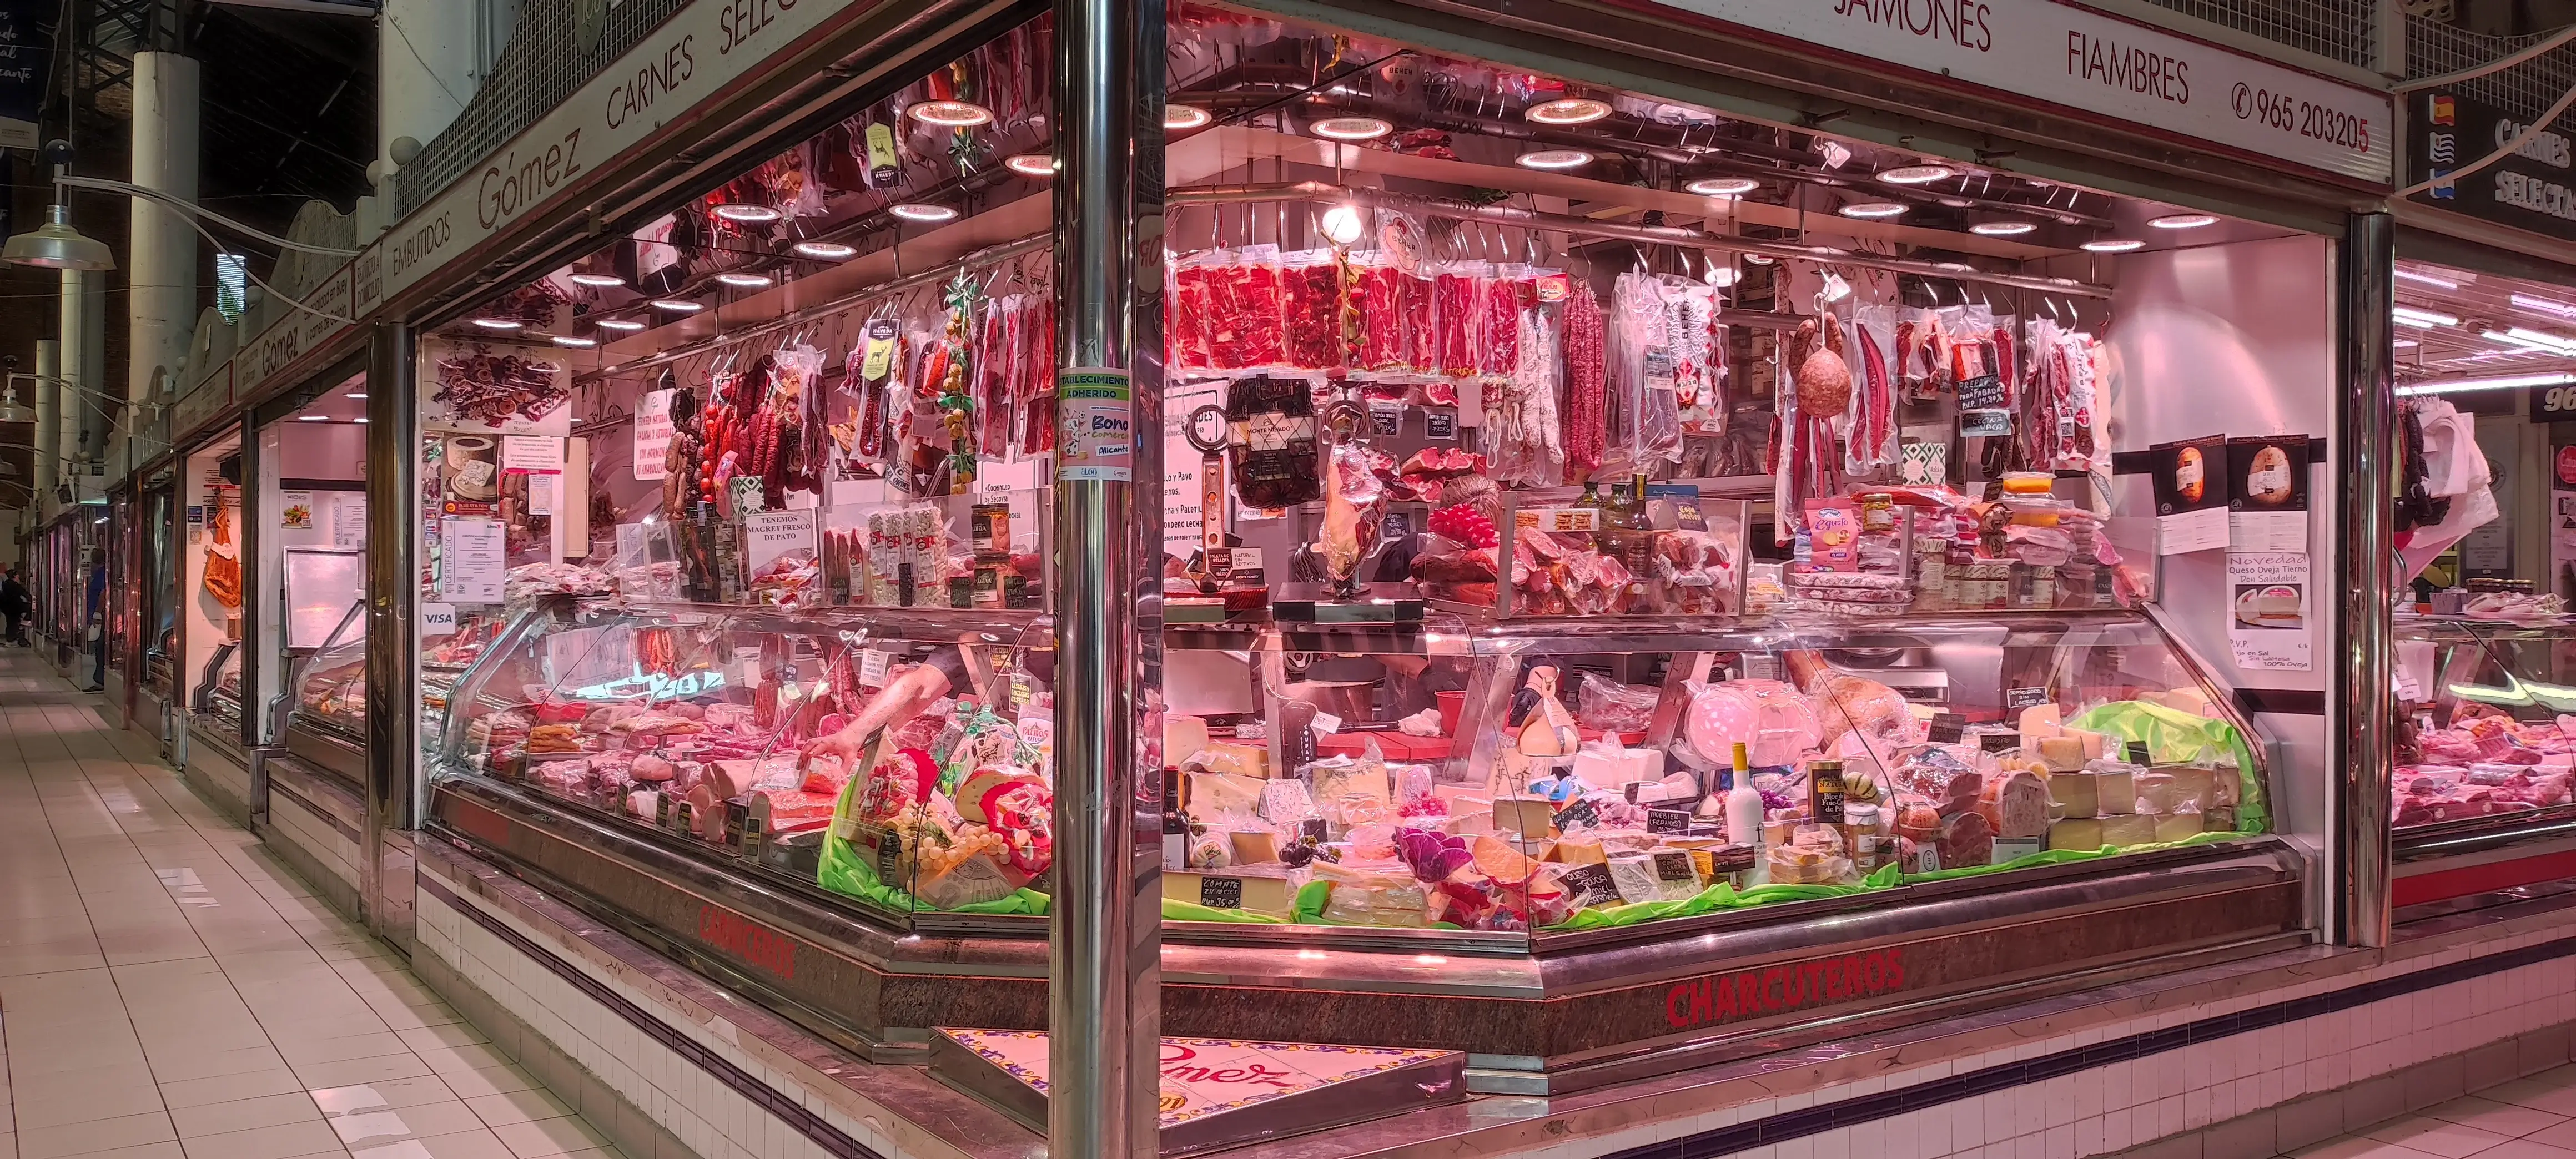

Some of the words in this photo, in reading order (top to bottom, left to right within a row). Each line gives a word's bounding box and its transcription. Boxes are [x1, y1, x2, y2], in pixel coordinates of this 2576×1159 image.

[721, 0, 797, 55] SELE
[2067, 29, 2189, 104] FIAMBRES
[607, 34, 693, 129] CARNES
[2257, 89, 2293, 131] 965
[2301, 101, 2368, 152] 203205
[478, 127, 581, 230] Gómez
[393, 211, 450, 276] EMBUTIDOS
[262, 326, 299, 377] Gómez
[1066, 390, 1116, 399] ADHERIDO
[1091, 414, 1129, 431] Bono
[1099, 445, 1129, 455] Alicante
[761, 516, 798, 524] TENEMOS
[747, 525, 782, 533] MAGRET
[2230, 555, 2306, 565] Novedad
[2257, 566, 2280, 575] Oveja
[2258, 575, 2297, 583] Saludable
[424, 614, 452, 623] VISA
[1566, 869, 1589, 881] QUESO
[1592, 884, 1613, 896] MIEL
[700, 905, 796, 979] CARNICEROS
[1666, 950, 1904, 1027] CHARCUTEROS
